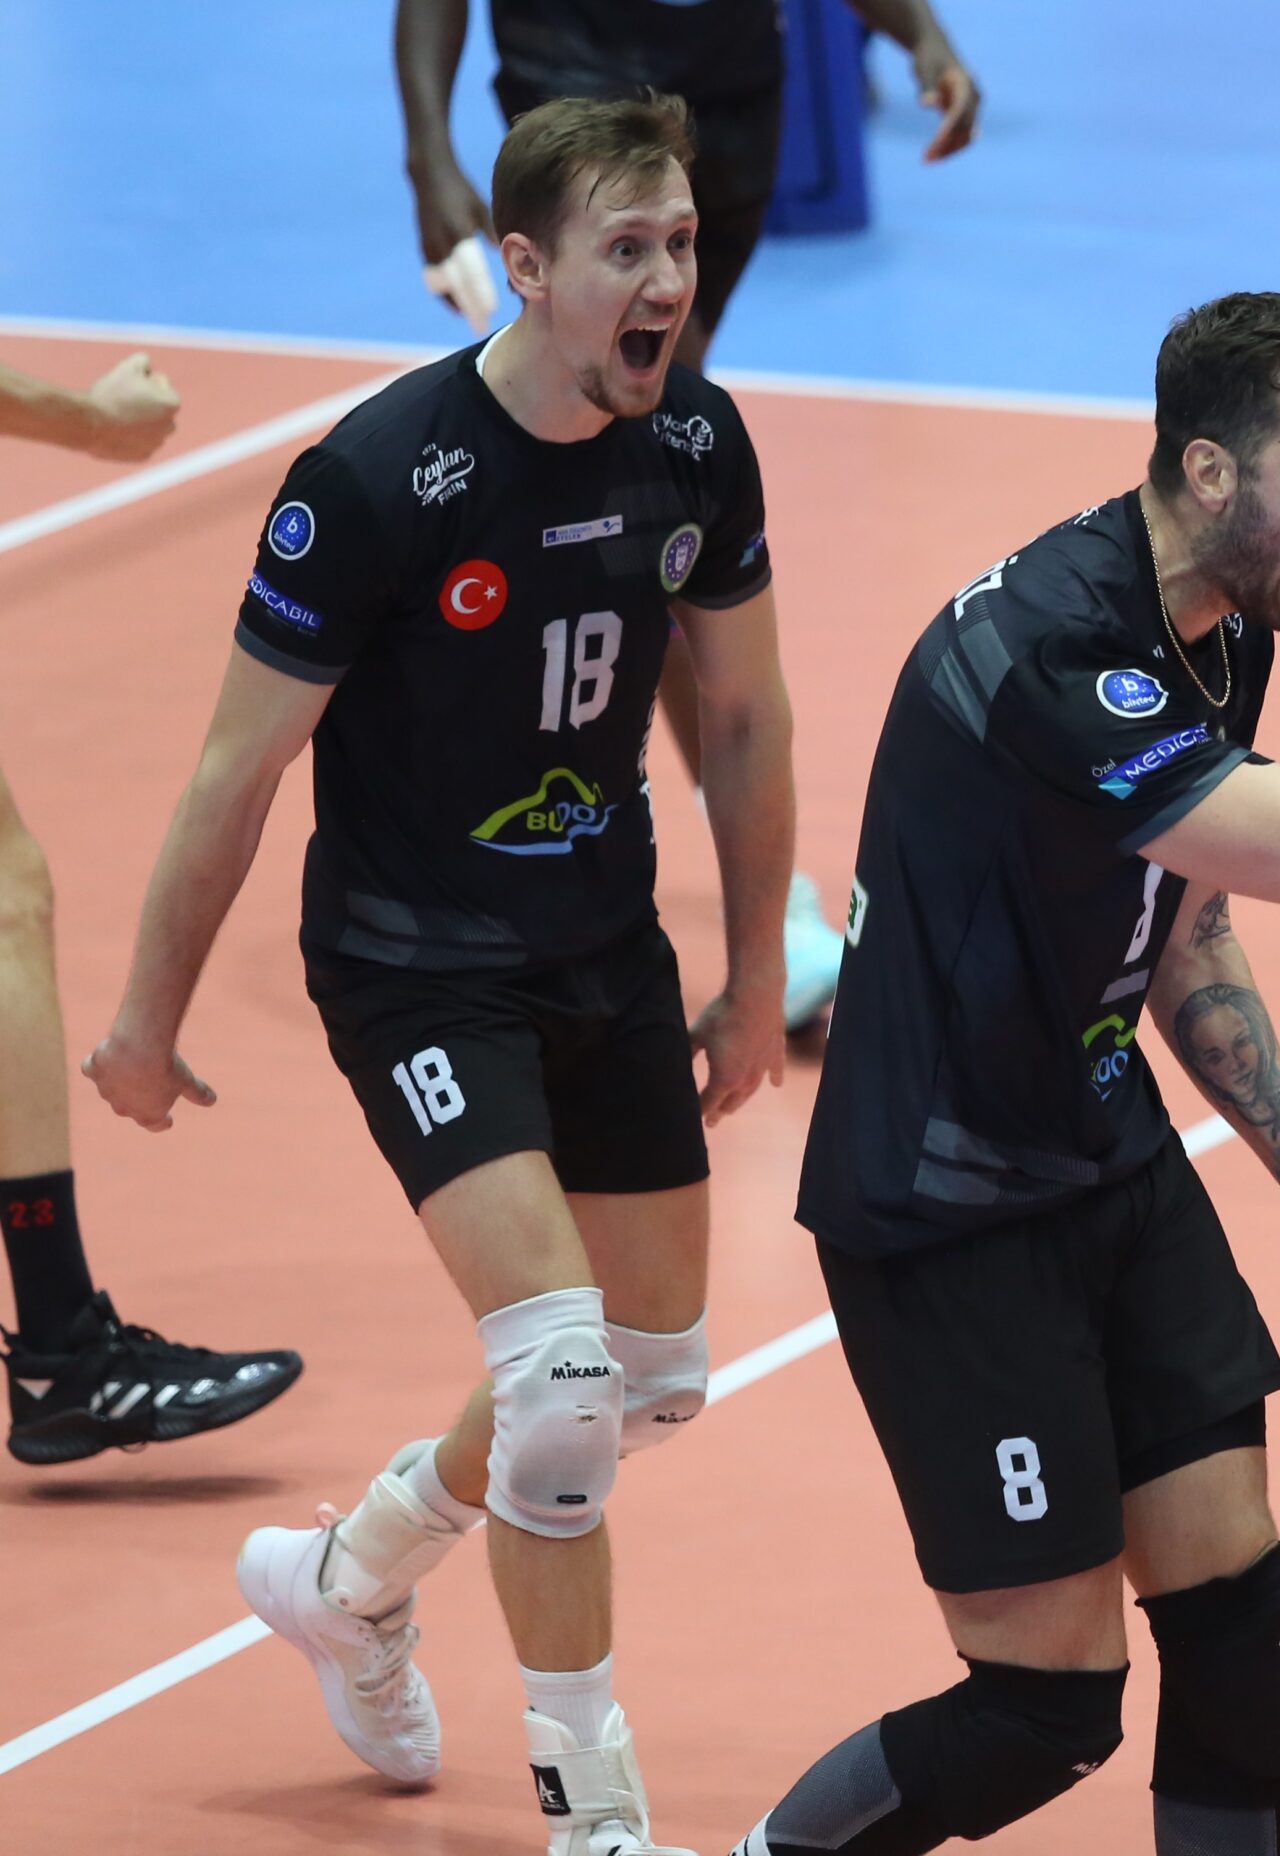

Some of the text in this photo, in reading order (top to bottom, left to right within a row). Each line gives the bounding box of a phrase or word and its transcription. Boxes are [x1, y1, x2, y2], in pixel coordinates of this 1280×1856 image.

[412, 447, 466, 496] Ceylan
[538, 610, 624, 732] 18
[527, 801, 597, 832] BUDO
[391, 1045, 467, 1137] 18
[9, 1199, 56, 1229] 23
[995, 1436, 1049, 1522] 8
